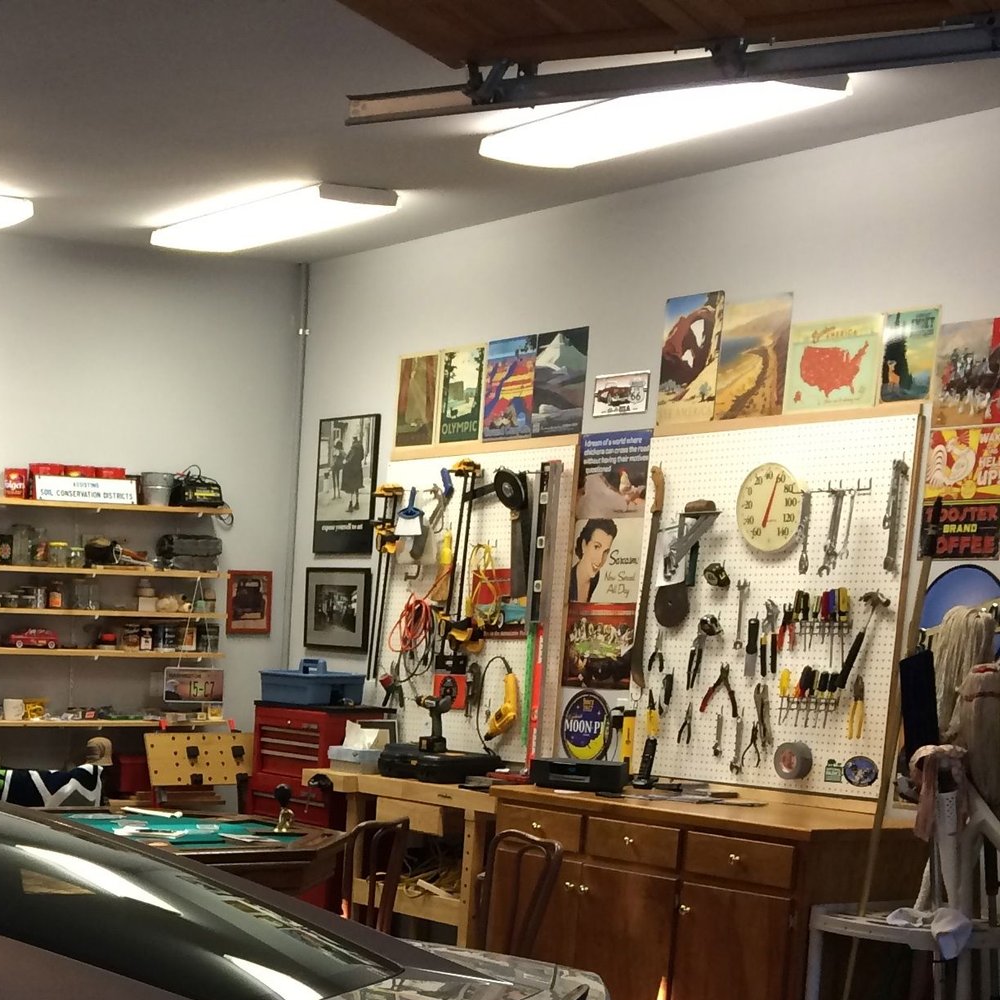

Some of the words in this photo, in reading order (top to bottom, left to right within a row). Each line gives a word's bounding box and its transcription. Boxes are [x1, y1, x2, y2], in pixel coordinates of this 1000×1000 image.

[442, 420, 478, 435] OLYMPIC
[40, 488, 53, 496] SOIL
[56, 490, 101, 498] CONSERVATION
[103, 492, 133, 500] DISTRICTS
[785, 498, 797, 507] 100
[783, 513, 795, 522] 120
[943, 523, 978, 534] BRAND
[935, 535, 995, 554] OFFEE
[189, 681, 215, 697] 15-C7
[564, 719, 593, 734] MOON
